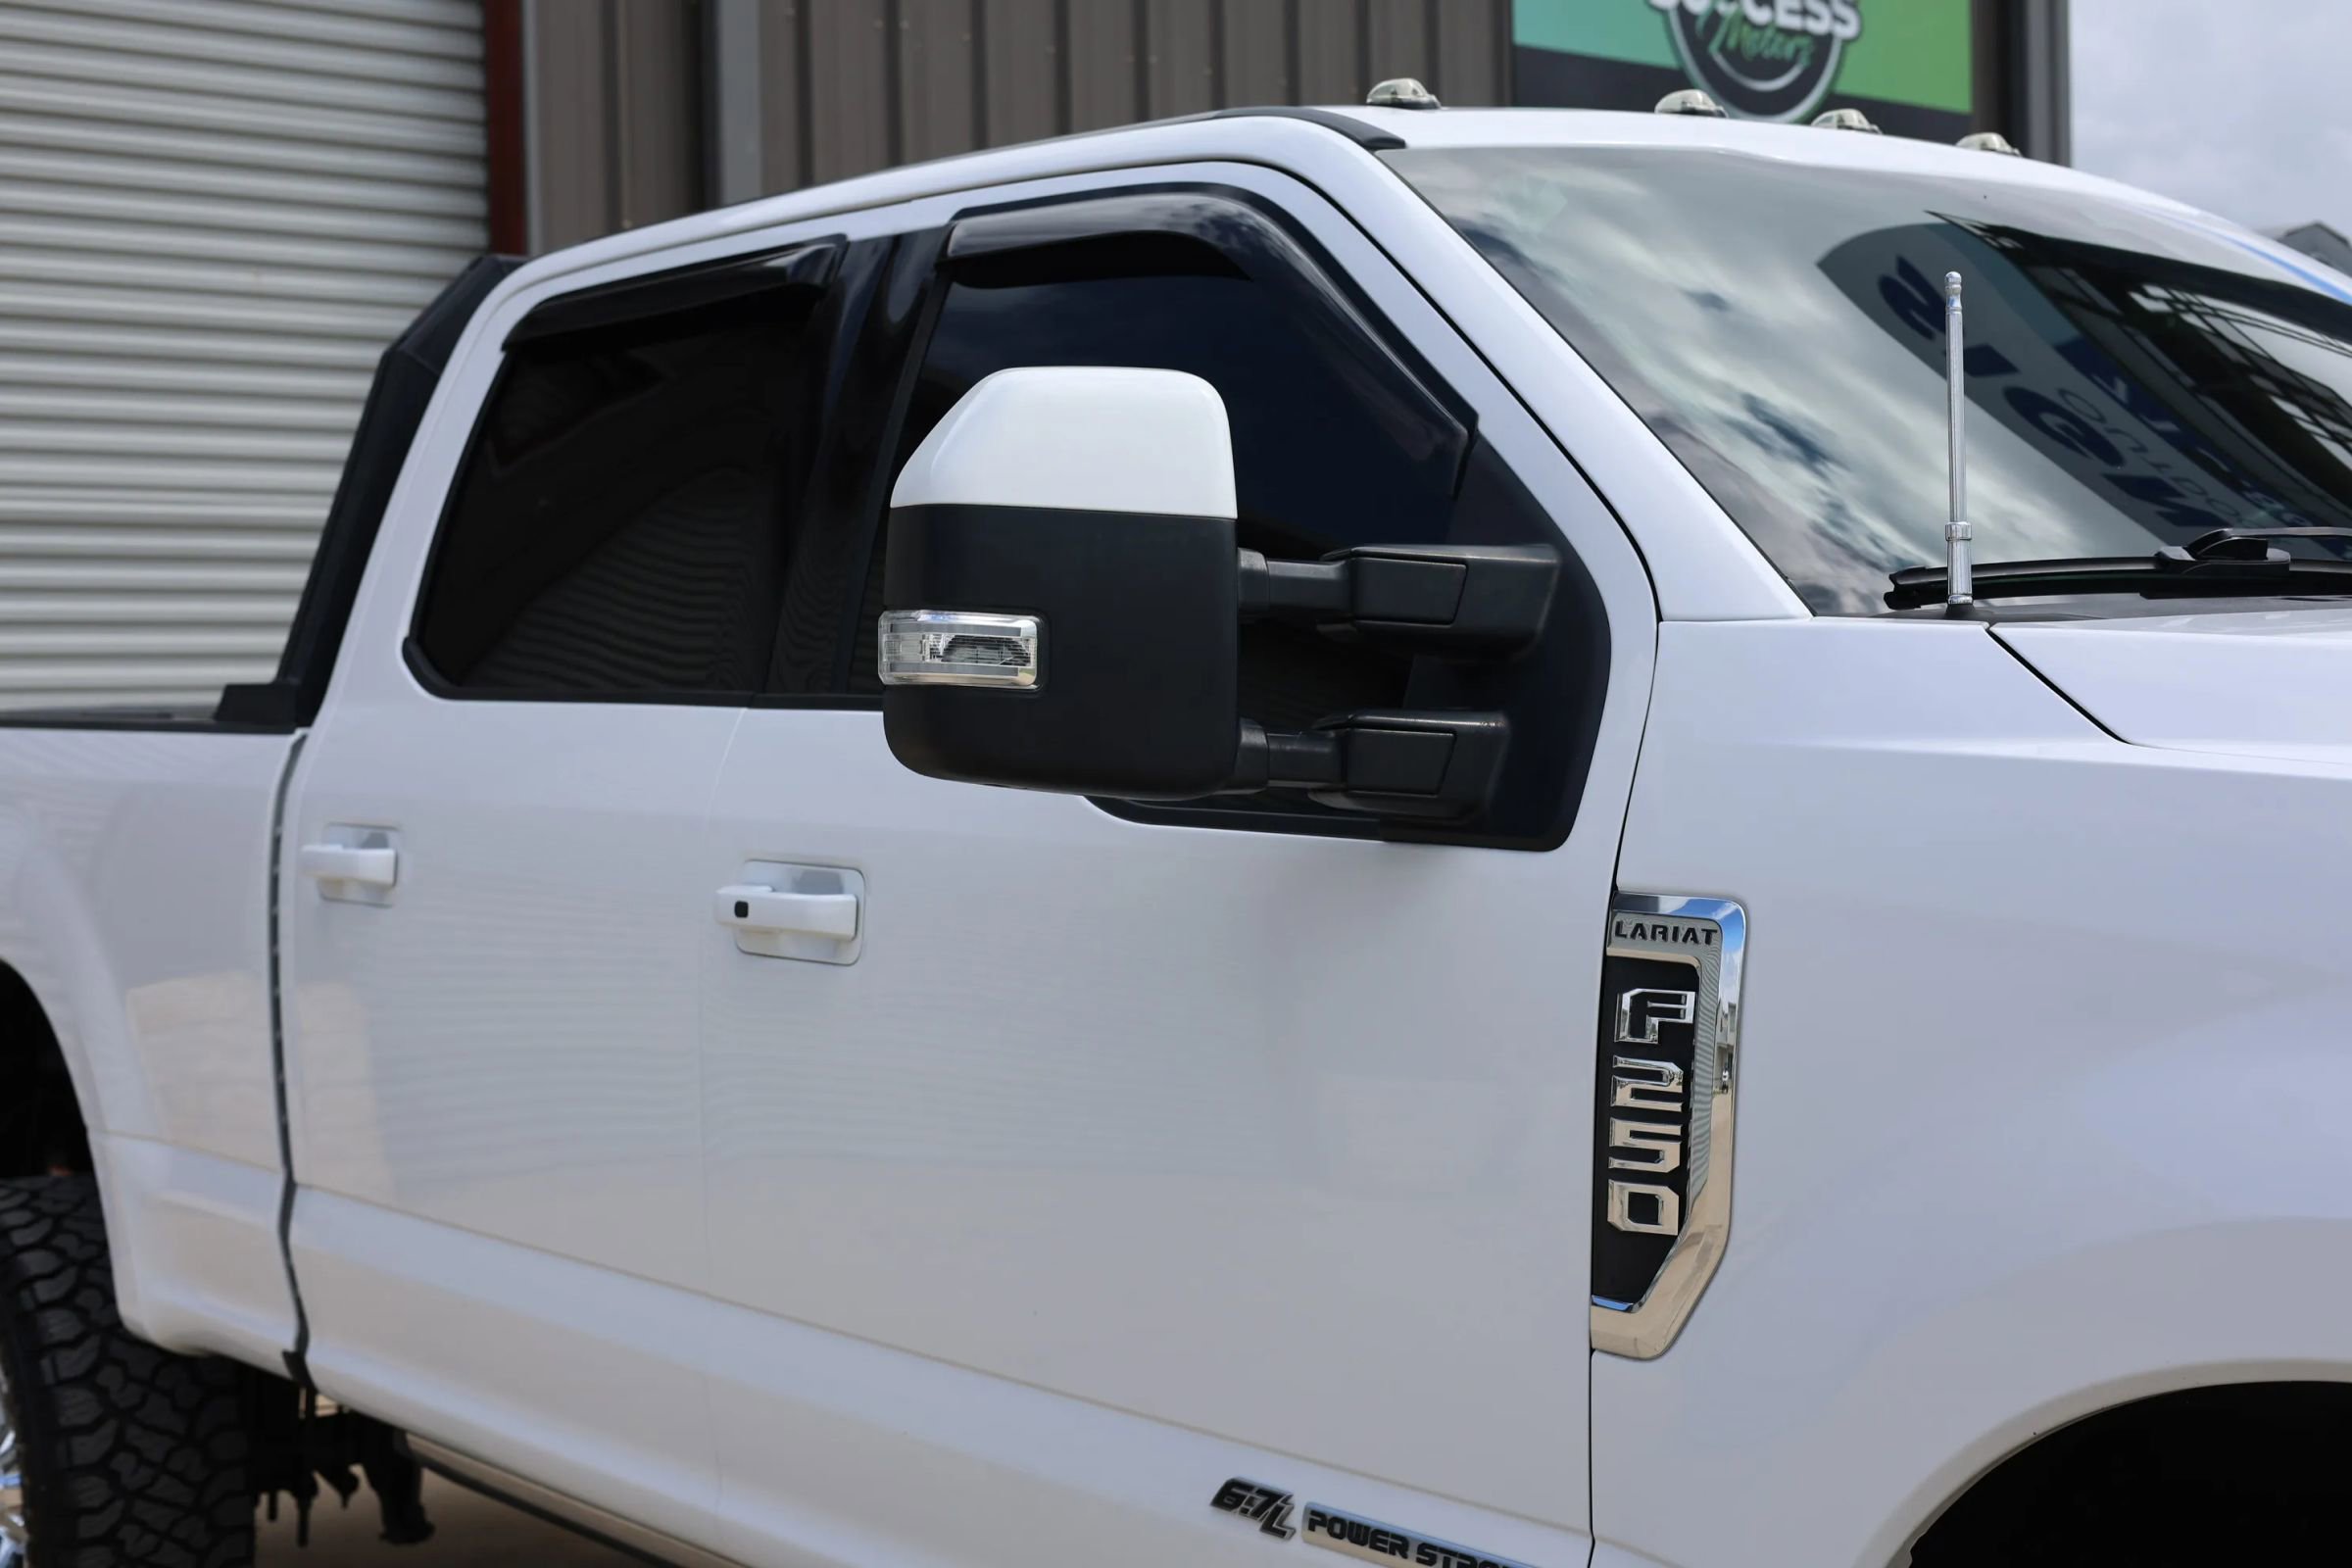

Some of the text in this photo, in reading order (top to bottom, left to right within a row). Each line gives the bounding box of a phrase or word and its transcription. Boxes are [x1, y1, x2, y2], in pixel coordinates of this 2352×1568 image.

[1644, 0, 1861, 40] CESS
[1614, 920, 1718, 945] LARIAT
[1607, 988, 1695, 1236] F250
[1210, 1476, 1515, 1568] 6.7L POWER STR
